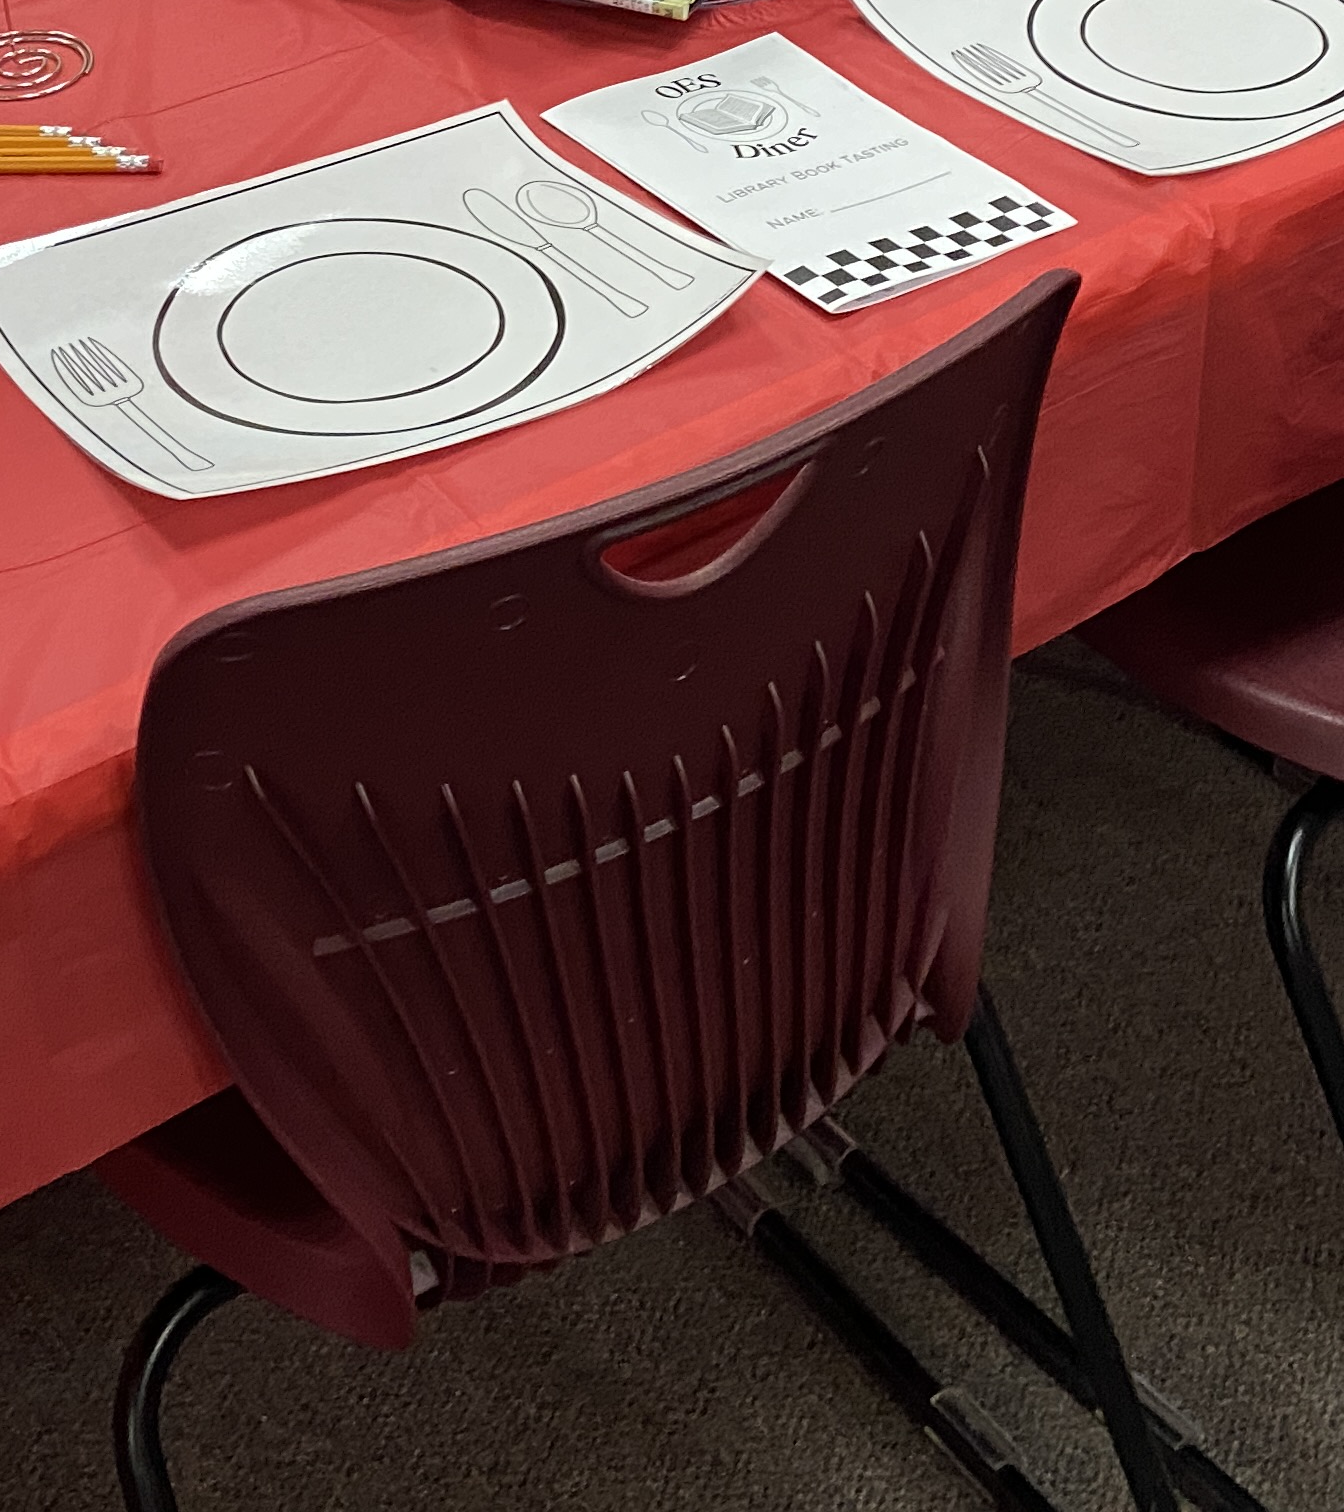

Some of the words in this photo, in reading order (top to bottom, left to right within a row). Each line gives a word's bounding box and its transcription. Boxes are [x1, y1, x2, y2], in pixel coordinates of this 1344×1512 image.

[654, 72, 722, 101] OES
[730, 127, 818, 160] Diner
[716, 175, 788, 204] LIBRARY
[790, 161, 842, 181] BOOK
[839, 137, 910, 164] TASTING
